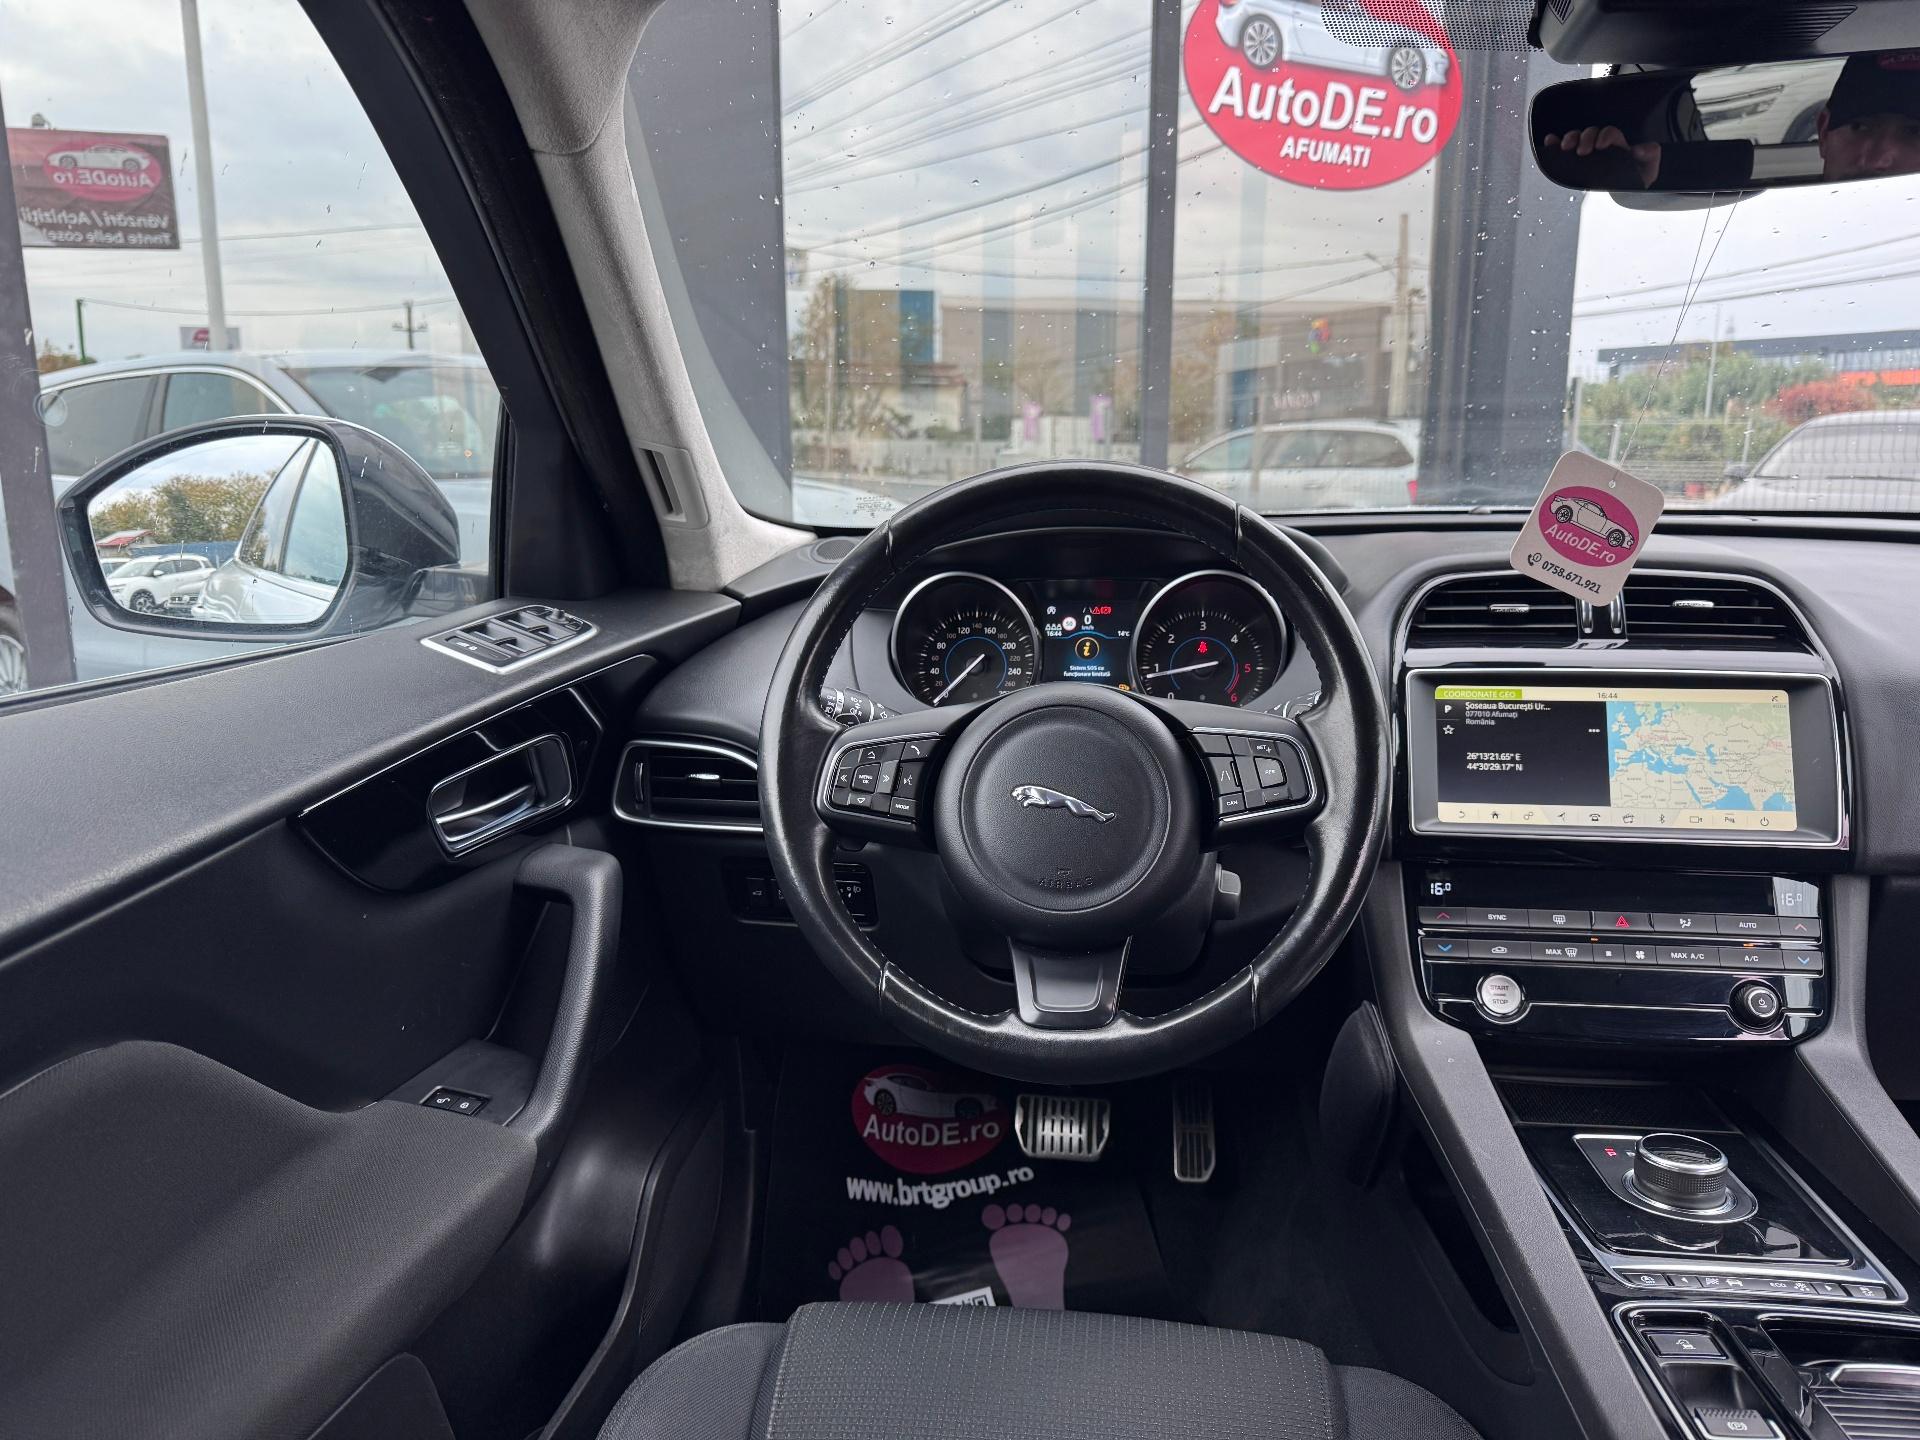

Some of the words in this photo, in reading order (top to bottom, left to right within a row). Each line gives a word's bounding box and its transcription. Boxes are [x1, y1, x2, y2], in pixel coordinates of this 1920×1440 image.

[1208, 66, 1438, 144] AutoDE.ro
[1280, 136, 1371, 168] AFUMATI
[1544, 524, 1616, 564] AutoDE.ro
[1542, 560, 1602, 594] 0758.671.921
[1084, 614, 1092, 625] 0
[1200, 621, 1207, 631] 3
[1168, 634, 1175, 643] 2
[1231, 634, 1239, 643] 4
[1002, 642, 1016, 650] 200
[1154, 663, 1159, 672] 1
[1244, 664, 1251, 672] 5
[1231, 693, 1238, 702] 6
[1515, 753, 1521, 761] E
[1516, 763, 1523, 771] N
[1739, 921, 1757, 929] AUTO
[863, 1113, 1000, 1147] AutoDE.ro
[846, 1166, 1034, 1209] www.brtgroup.ro
